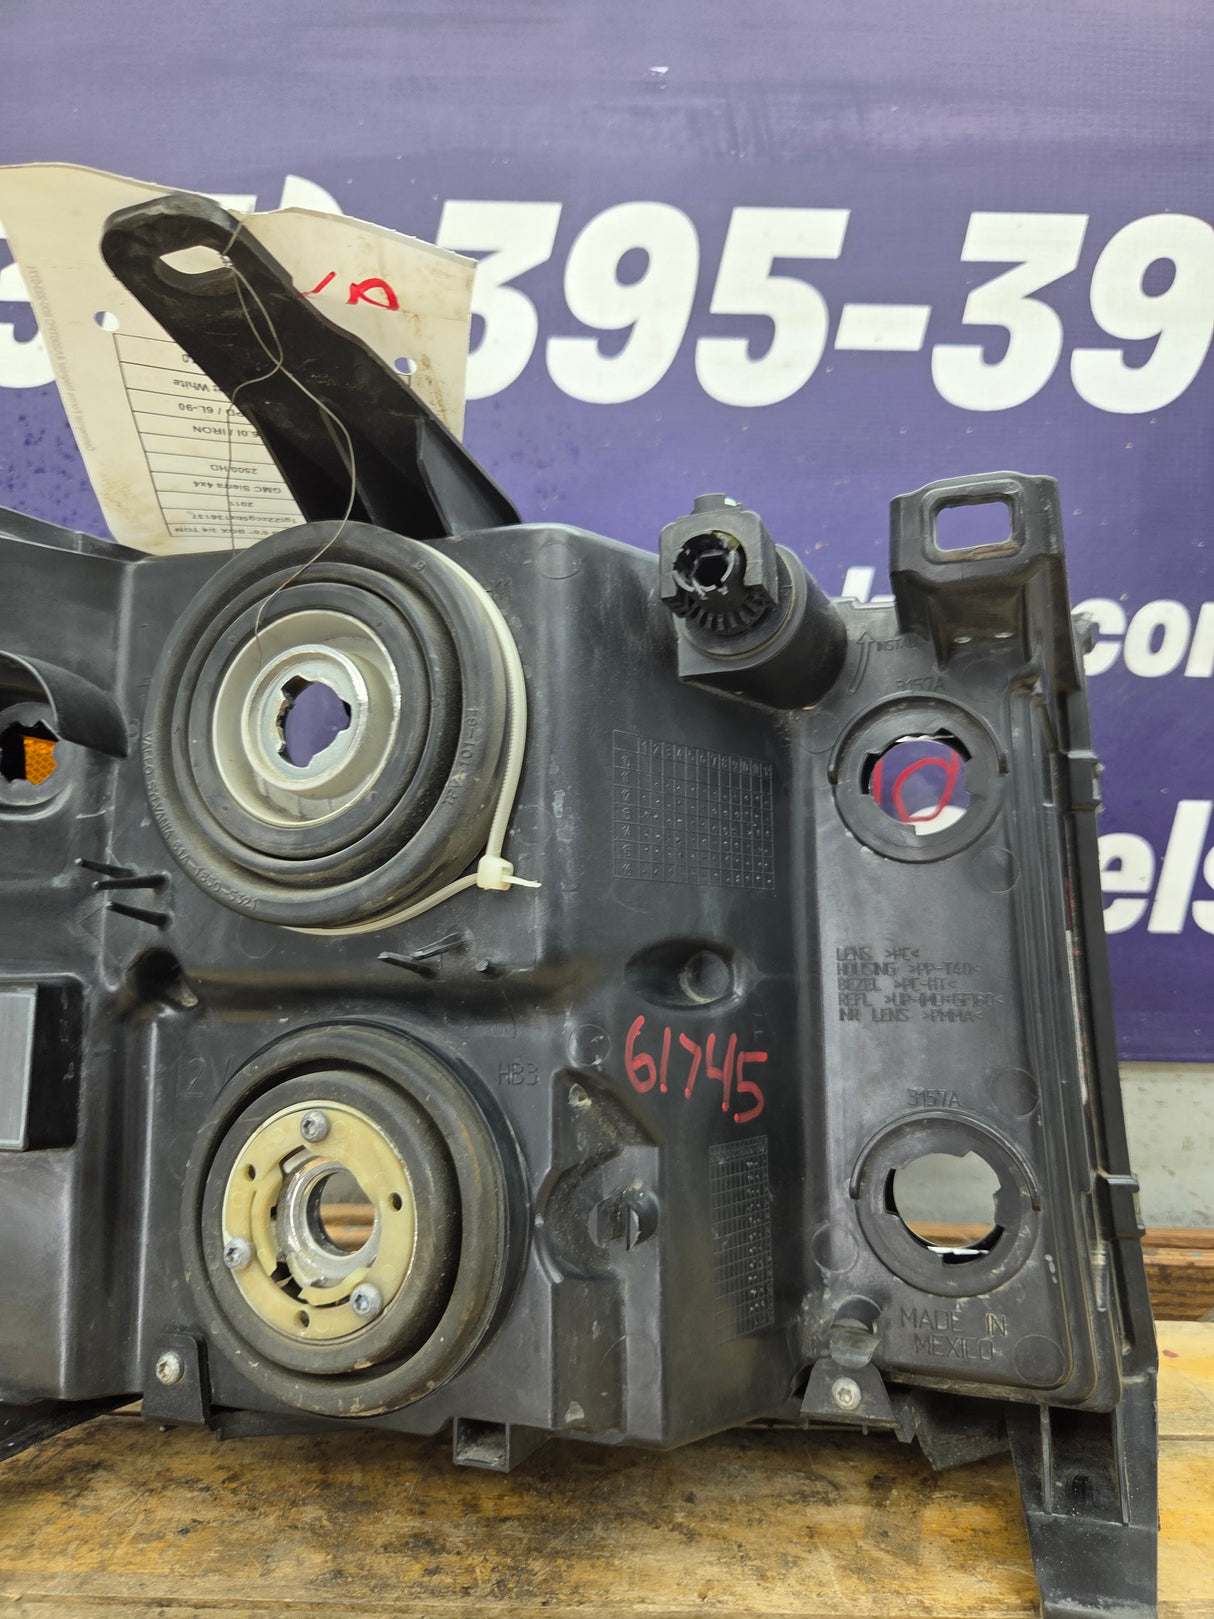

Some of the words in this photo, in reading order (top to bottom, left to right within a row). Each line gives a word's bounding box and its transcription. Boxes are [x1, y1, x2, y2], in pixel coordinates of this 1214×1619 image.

[173, 379, 210, 392] White
[178, 403, 213, 414] 6L-90
[192, 425, 226, 436] IRON
[216, 483, 250, 492] Sierra
[255, 485, 281, 494] GMC
[836, 946, 873, 961] LENS
[837, 978, 882, 992] BEZEL
[872, 1008, 911, 1022] LENS
[498, 1062, 540, 1087] HB3
[624, 1015, 768, 1124] 61745
[906, 1087, 961, 1108] 3157A
[900, 1305, 962, 1333] MADE
[985, 1312, 1010, 1338] IN
[914, 1334, 996, 1362] MEXICO
